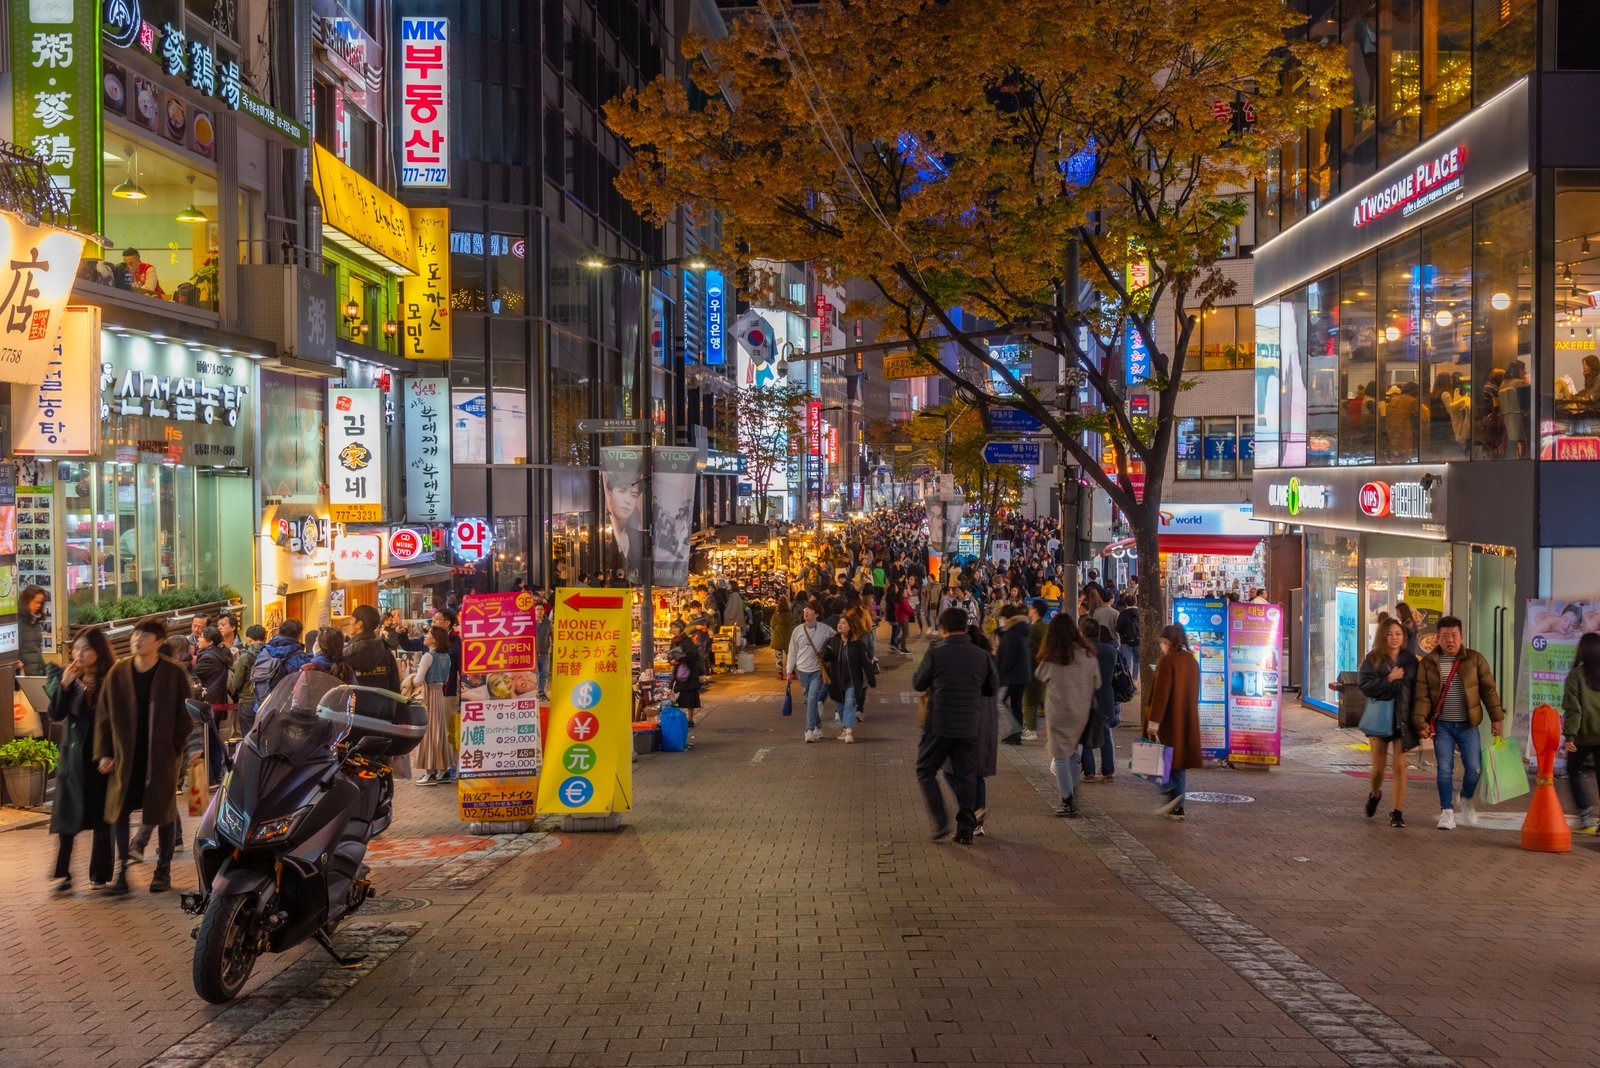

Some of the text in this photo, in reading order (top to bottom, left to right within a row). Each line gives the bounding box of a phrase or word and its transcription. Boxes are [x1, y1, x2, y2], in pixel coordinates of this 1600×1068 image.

[403, 21, 446, 40] MK
[161, 22, 241, 110] 蔘鷄湯
[405, 45, 443, 163] 부동산
[403, 168, 446, 182] 777-7727
[1353, 147, 1459, 227] A TWOSOME PLACE
[0, 247, 50, 334] 店
[423, 263, 446, 331] 돈까스
[308, 297, 327, 346] 粥
[407, 303, 425, 354] 모밀
[709, 299, 721, 350] 우리은행
[1571, 341, 1595, 350] FREE
[421, 405, 438, 456] 부대찌개
[1215, 441, 1225, 454] ¥
[1363, 490, 1377, 507] VIPS
[336, 511, 377, 521] 777-3231
[1176, 515, 1203, 524] world
[457, 522, 486, 558] 약
[518, 596, 532, 608] 3F
[1408, 589, 1442, 598] 환상적 케미
[465, 601, 503, 618] ベラ
[1247, 606, 1265, 616] 태닝
[464, 615, 534, 638] エステ
[558, 619, 607, 630] MONEY
[558, 630, 620, 641] EXCHAGE
[1532, 638, 1546, 649] 6F
[467, 640, 508, 671] 24
[501, 642, 531, 653] OPEN
[508, 655, 531, 665] 時間
[556, 662, 582, 676] 両替
[577, 683, 592, 708] $
[462, 702, 486, 722] 足
[485, 701, 517, 711] マッサージ
[461, 725, 486, 746] 小顔
[574, 717, 591, 739] ¥
[461, 749, 485, 769] 全身
[484, 750, 517, 759] マッサージ
[567, 747, 591, 770] 元
[463, 790, 533, 802] 格安アートメイク
[565, 780, 586, 804] €
[464, 805, 534, 819] 02.754.5050
